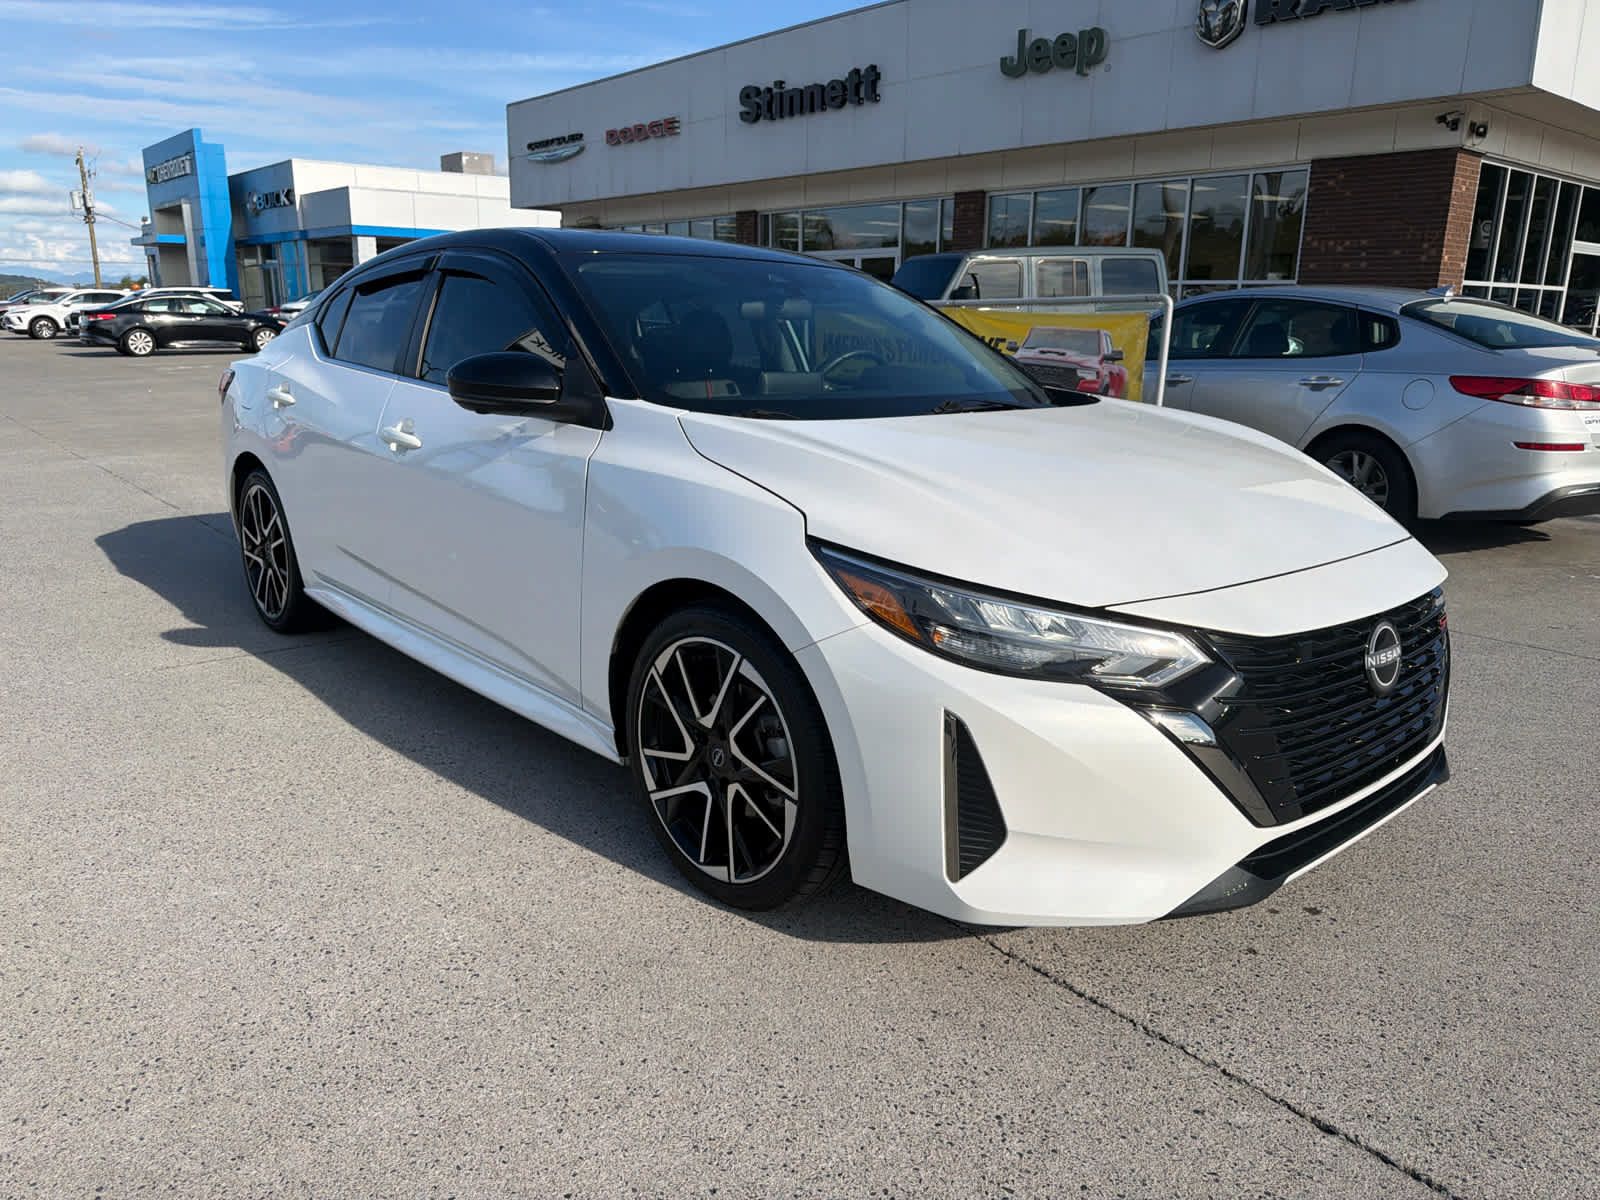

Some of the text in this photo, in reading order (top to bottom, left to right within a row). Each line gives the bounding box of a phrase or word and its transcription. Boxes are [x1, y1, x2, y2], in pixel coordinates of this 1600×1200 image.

[1000, 27, 1110, 78] Jeep
[739, 64, 882, 124] Stinnett
[605, 116, 681, 145] DODGE
[256, 187, 290, 209] BUICK
[1367, 644, 1402, 668] NISSAN
